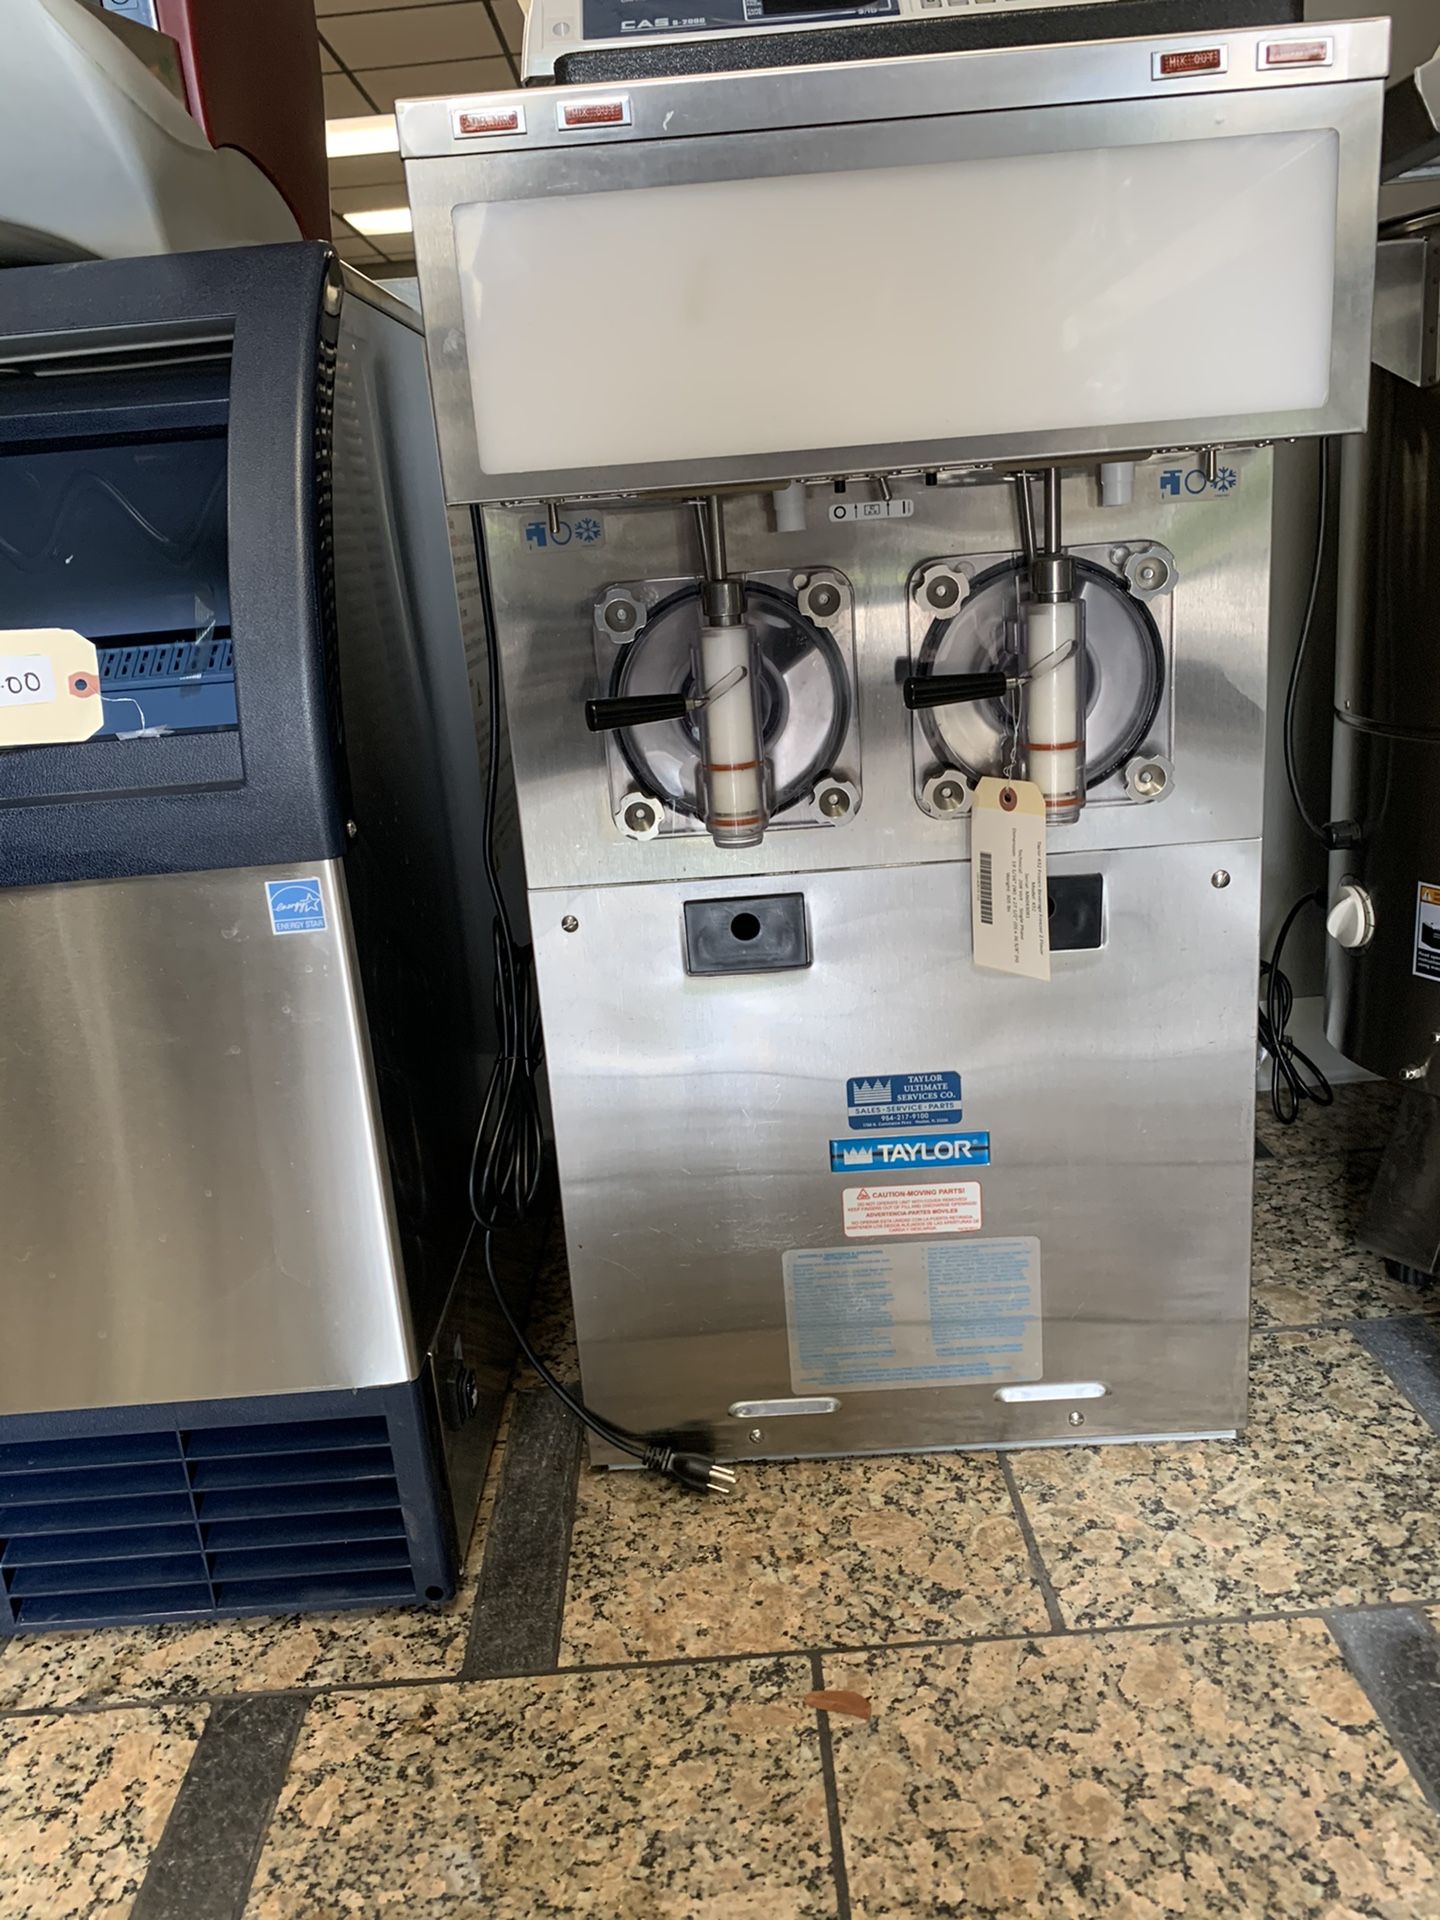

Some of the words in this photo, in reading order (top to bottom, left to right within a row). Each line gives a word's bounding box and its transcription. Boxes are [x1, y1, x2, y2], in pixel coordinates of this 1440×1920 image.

[621, 17, 669, 30] CAS
[276, 920, 304, 931] ENERGY
[305, 919, 323, 929] STAR
[908, 1074, 943, 1083] TAYLOR
[904, 1082, 948, 1092] ULTIMATE
[897, 1092, 938, 1101] SERVICES
[940, 1091, 956, 1099] CO.
[876, 1140, 973, 1163] TAYLOR
